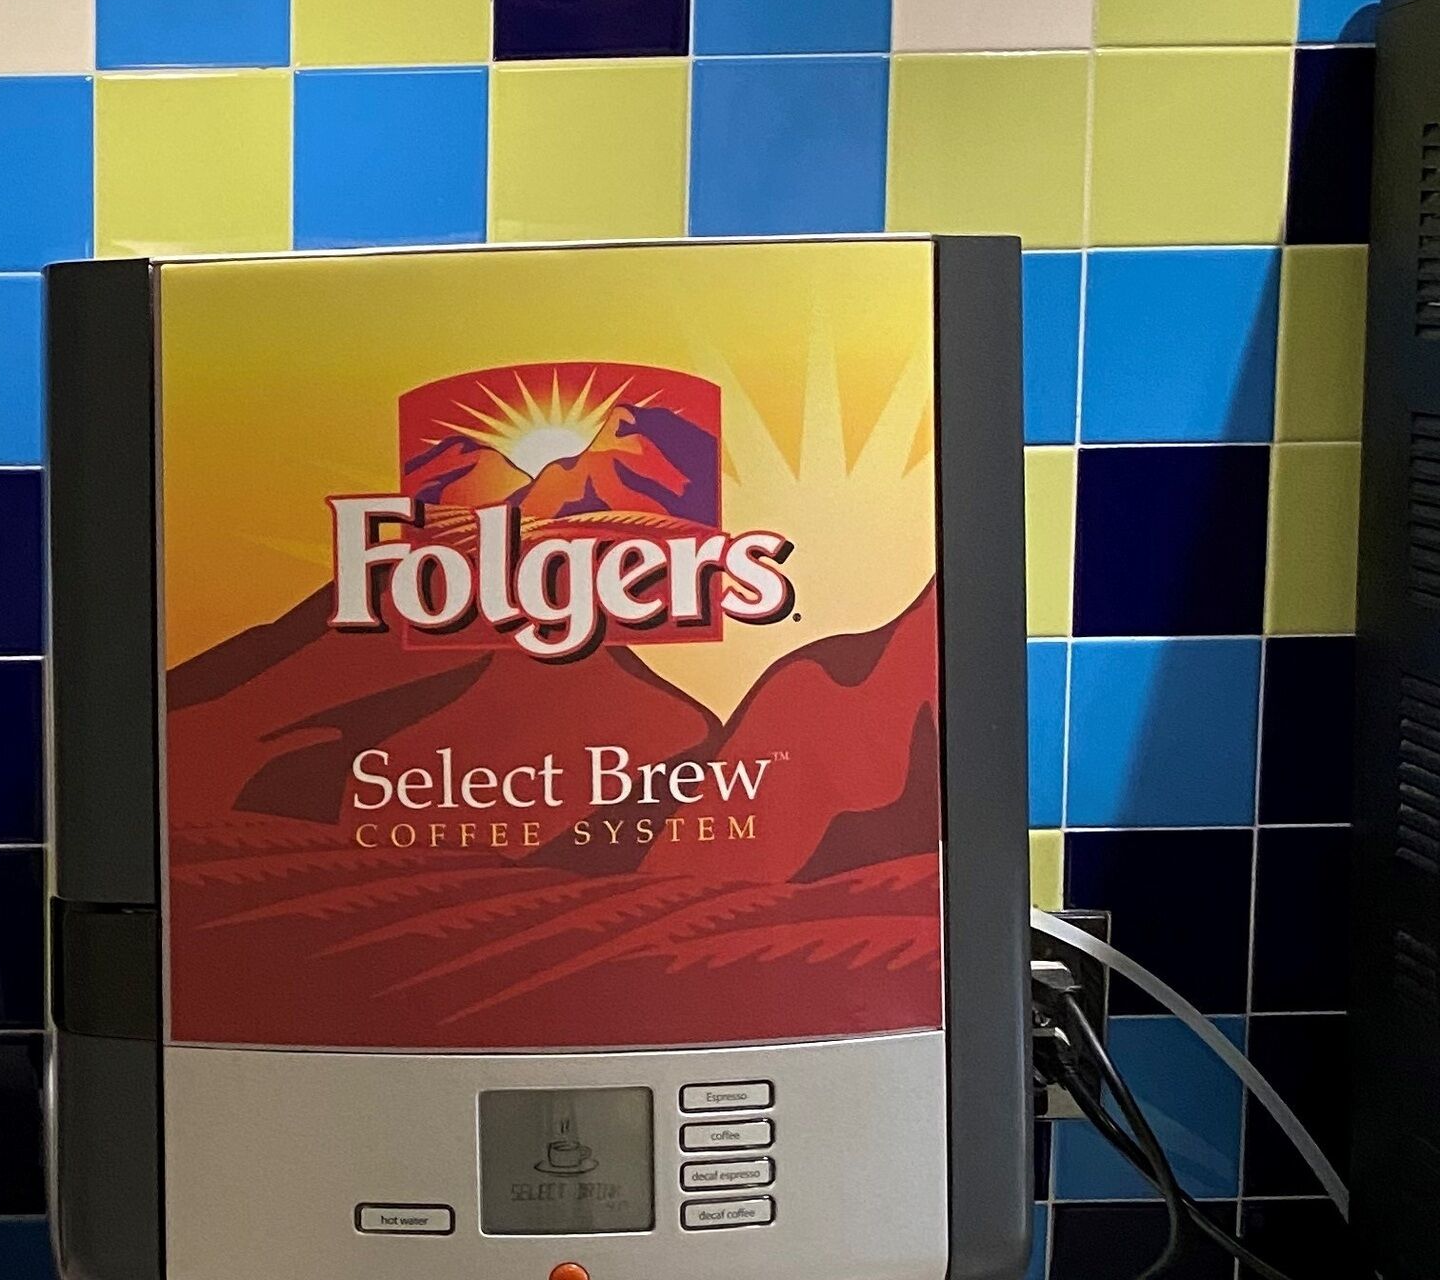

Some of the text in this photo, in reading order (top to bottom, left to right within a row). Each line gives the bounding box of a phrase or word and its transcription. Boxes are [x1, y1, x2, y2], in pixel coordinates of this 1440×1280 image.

[326, 494, 795, 665] Folgers
[352, 746, 563, 810] Select
[585, 745, 772, 806] Brew
[355, 815, 757, 848] COFFEE SYSTEM
[706, 1091, 748, 1103] Espresso
[711, 1130, 740, 1141] coffee
[691, 1170, 761, 1182] decaf espresso
[380, 1215, 428, 1226] hot water
[698, 1207, 756, 1221] decaf coffee
